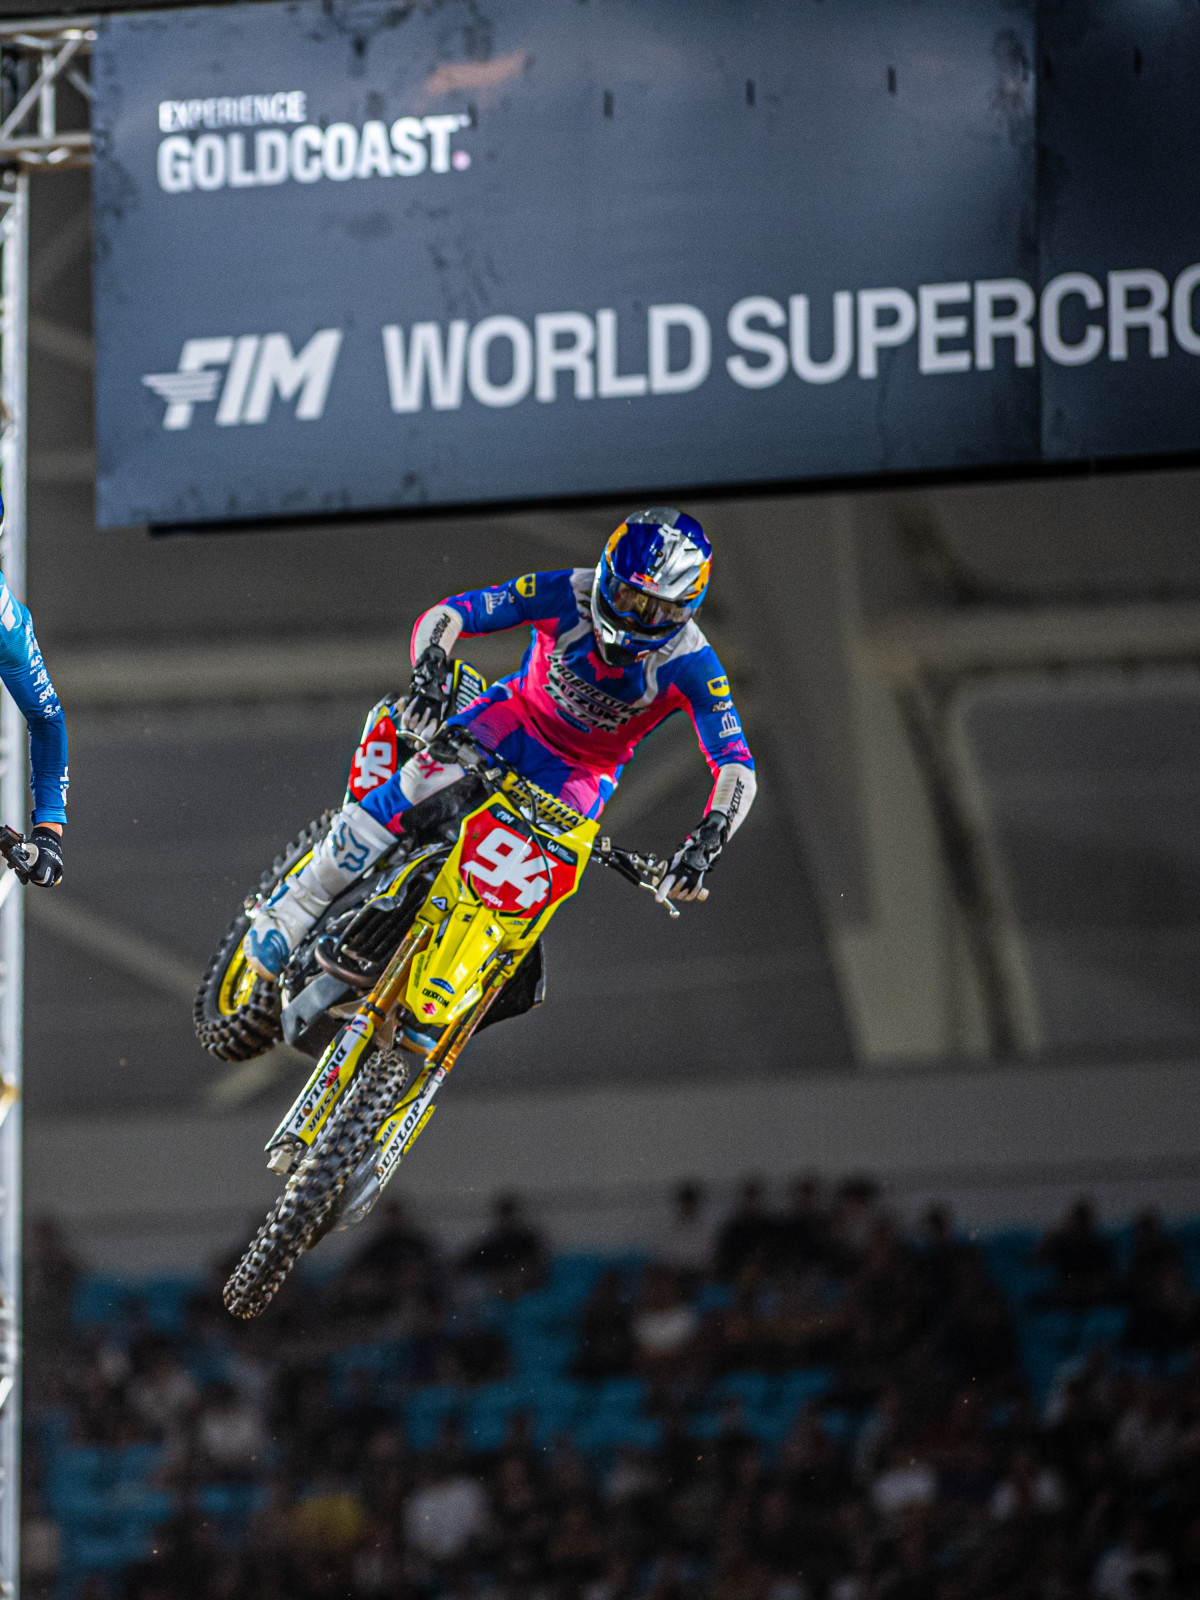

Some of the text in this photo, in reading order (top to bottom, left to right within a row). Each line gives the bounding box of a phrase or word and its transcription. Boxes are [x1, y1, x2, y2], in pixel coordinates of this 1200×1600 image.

[159, 91, 306, 132] EXPERIENCE
[143, 328, 342, 430] FIM
[382, 302, 712, 415] WORLD
[545, 653, 650, 718] PROGRESSIVE
[546, 671, 630, 726] SUZUKI
[353, 741, 393, 789] 94
[460, 827, 559, 909] 94
[295, 1045, 348, 1132] DUNLOP
[375, 1101, 420, 1182] DUNLOP
